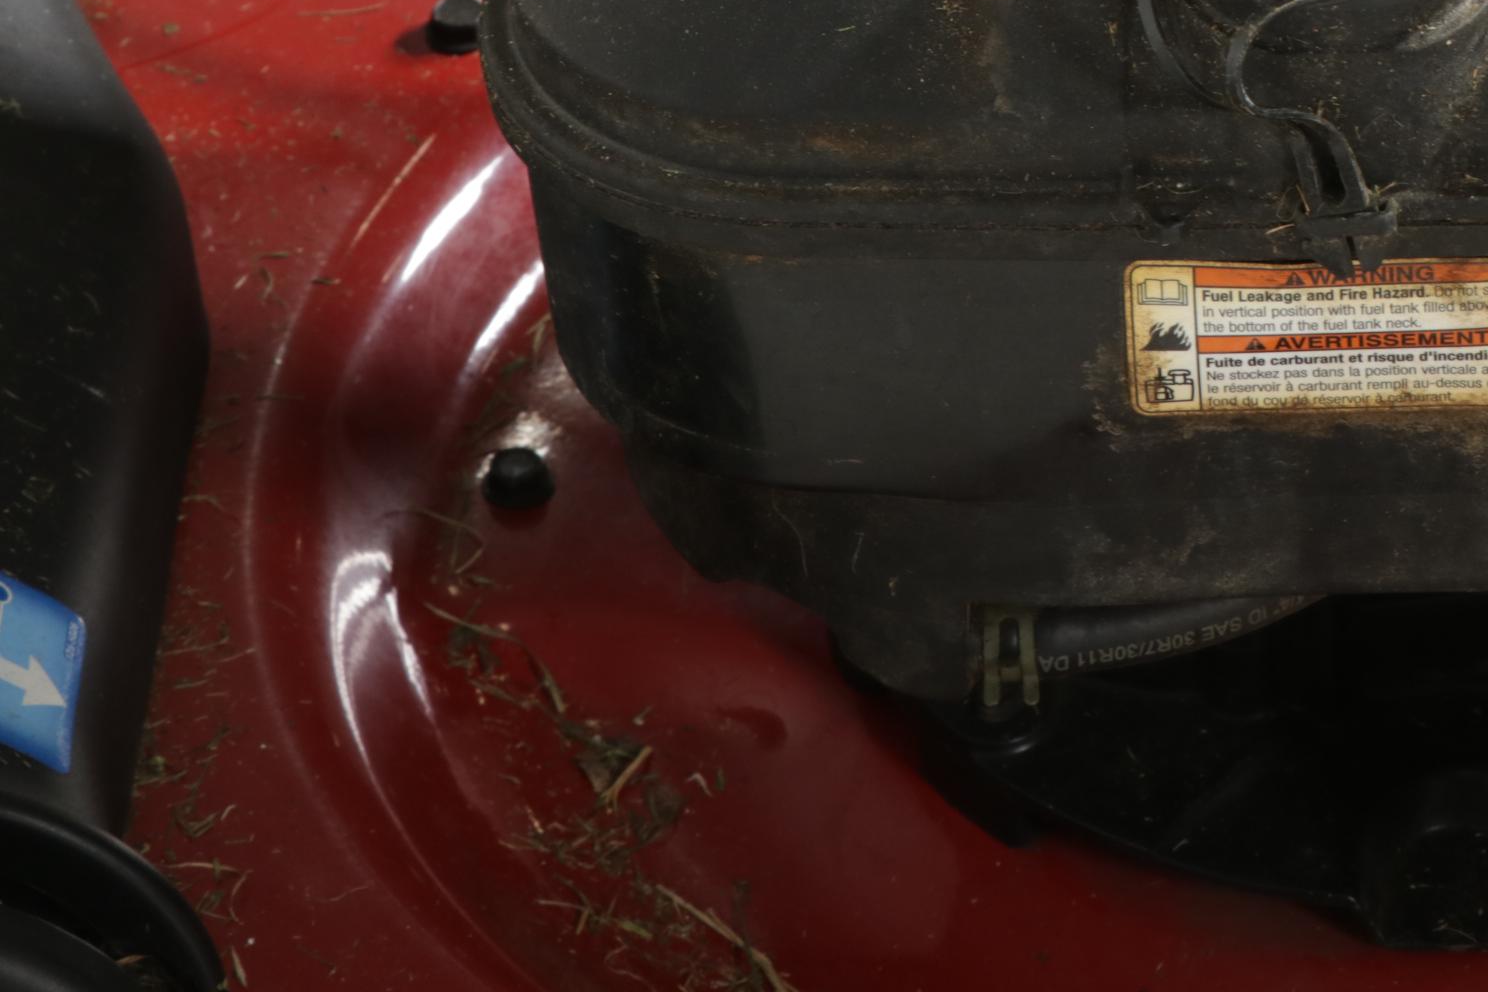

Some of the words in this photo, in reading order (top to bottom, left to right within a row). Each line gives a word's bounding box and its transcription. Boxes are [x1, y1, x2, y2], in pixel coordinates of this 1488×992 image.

[1202, 289, 1234, 303] Fuel
[1238, 289, 1302, 305] Leakage
[1306, 289, 1335, 302] and
[1339, 288, 1368, 301] Fire
[1373, 286, 1430, 300] Hazard.
[1457, 283, 1480, 296] not
[1202, 306, 1215, 318] in
[1218, 305, 1267, 319] vertical
[1271, 304, 1324, 320] position
[1328, 303, 1356, 316] with
[1360, 303, 1385, 316] fuel
[1390, 301, 1420, 315] tank
[1423, 300, 1456, 313] filled
[1203, 321, 1225, 333] the
[1228, 321, 1276, 333] bottom
[1280, 320, 1294, 332] of
[1297, 319, 1319, 331] the
[1323, 319, 1348, 331] fuel
[1352, 317, 1382, 330] tank
[1386, 317, 1422, 329] neck.
[1206, 356, 1243, 368] Fuite
[1247, 355, 1266, 367] de
[1270, 353, 1345, 366] carburant
[1348, 353, 1364, 364] et
[1367, 351, 1415, 365] risque
[1207, 370, 1226, 381] Ne
[1229, 368, 1281, 381] stockez
[1284, 369, 1308, 381] pas
[1312, 367, 1345, 379] dans
[1349, 366, 1361, 378] la
[1365, 364, 1418, 379] position
[1421, 362, 1478, 376] verticale
[1207, 383, 1220, 394] le
[1223, 380, 1282, 394] réservoir
[1285, 379, 1295, 392] à
[1298, 379, 1364, 393] carburant
[1367, 378, 1409, 392] rempli
[1413, 377, 1483, 390] au-dessus
[1208, 395, 1238, 408] fond
[1242, 395, 1260, 408] du
[1313, 392, 1371, 407] réservoir
[1374, 392, 1384, 404] à
[1247, 607, 1271, 625] ID
[1201, 616, 1243, 640] SAE
[1076, 630, 1196, 668] 30R7/30R11
